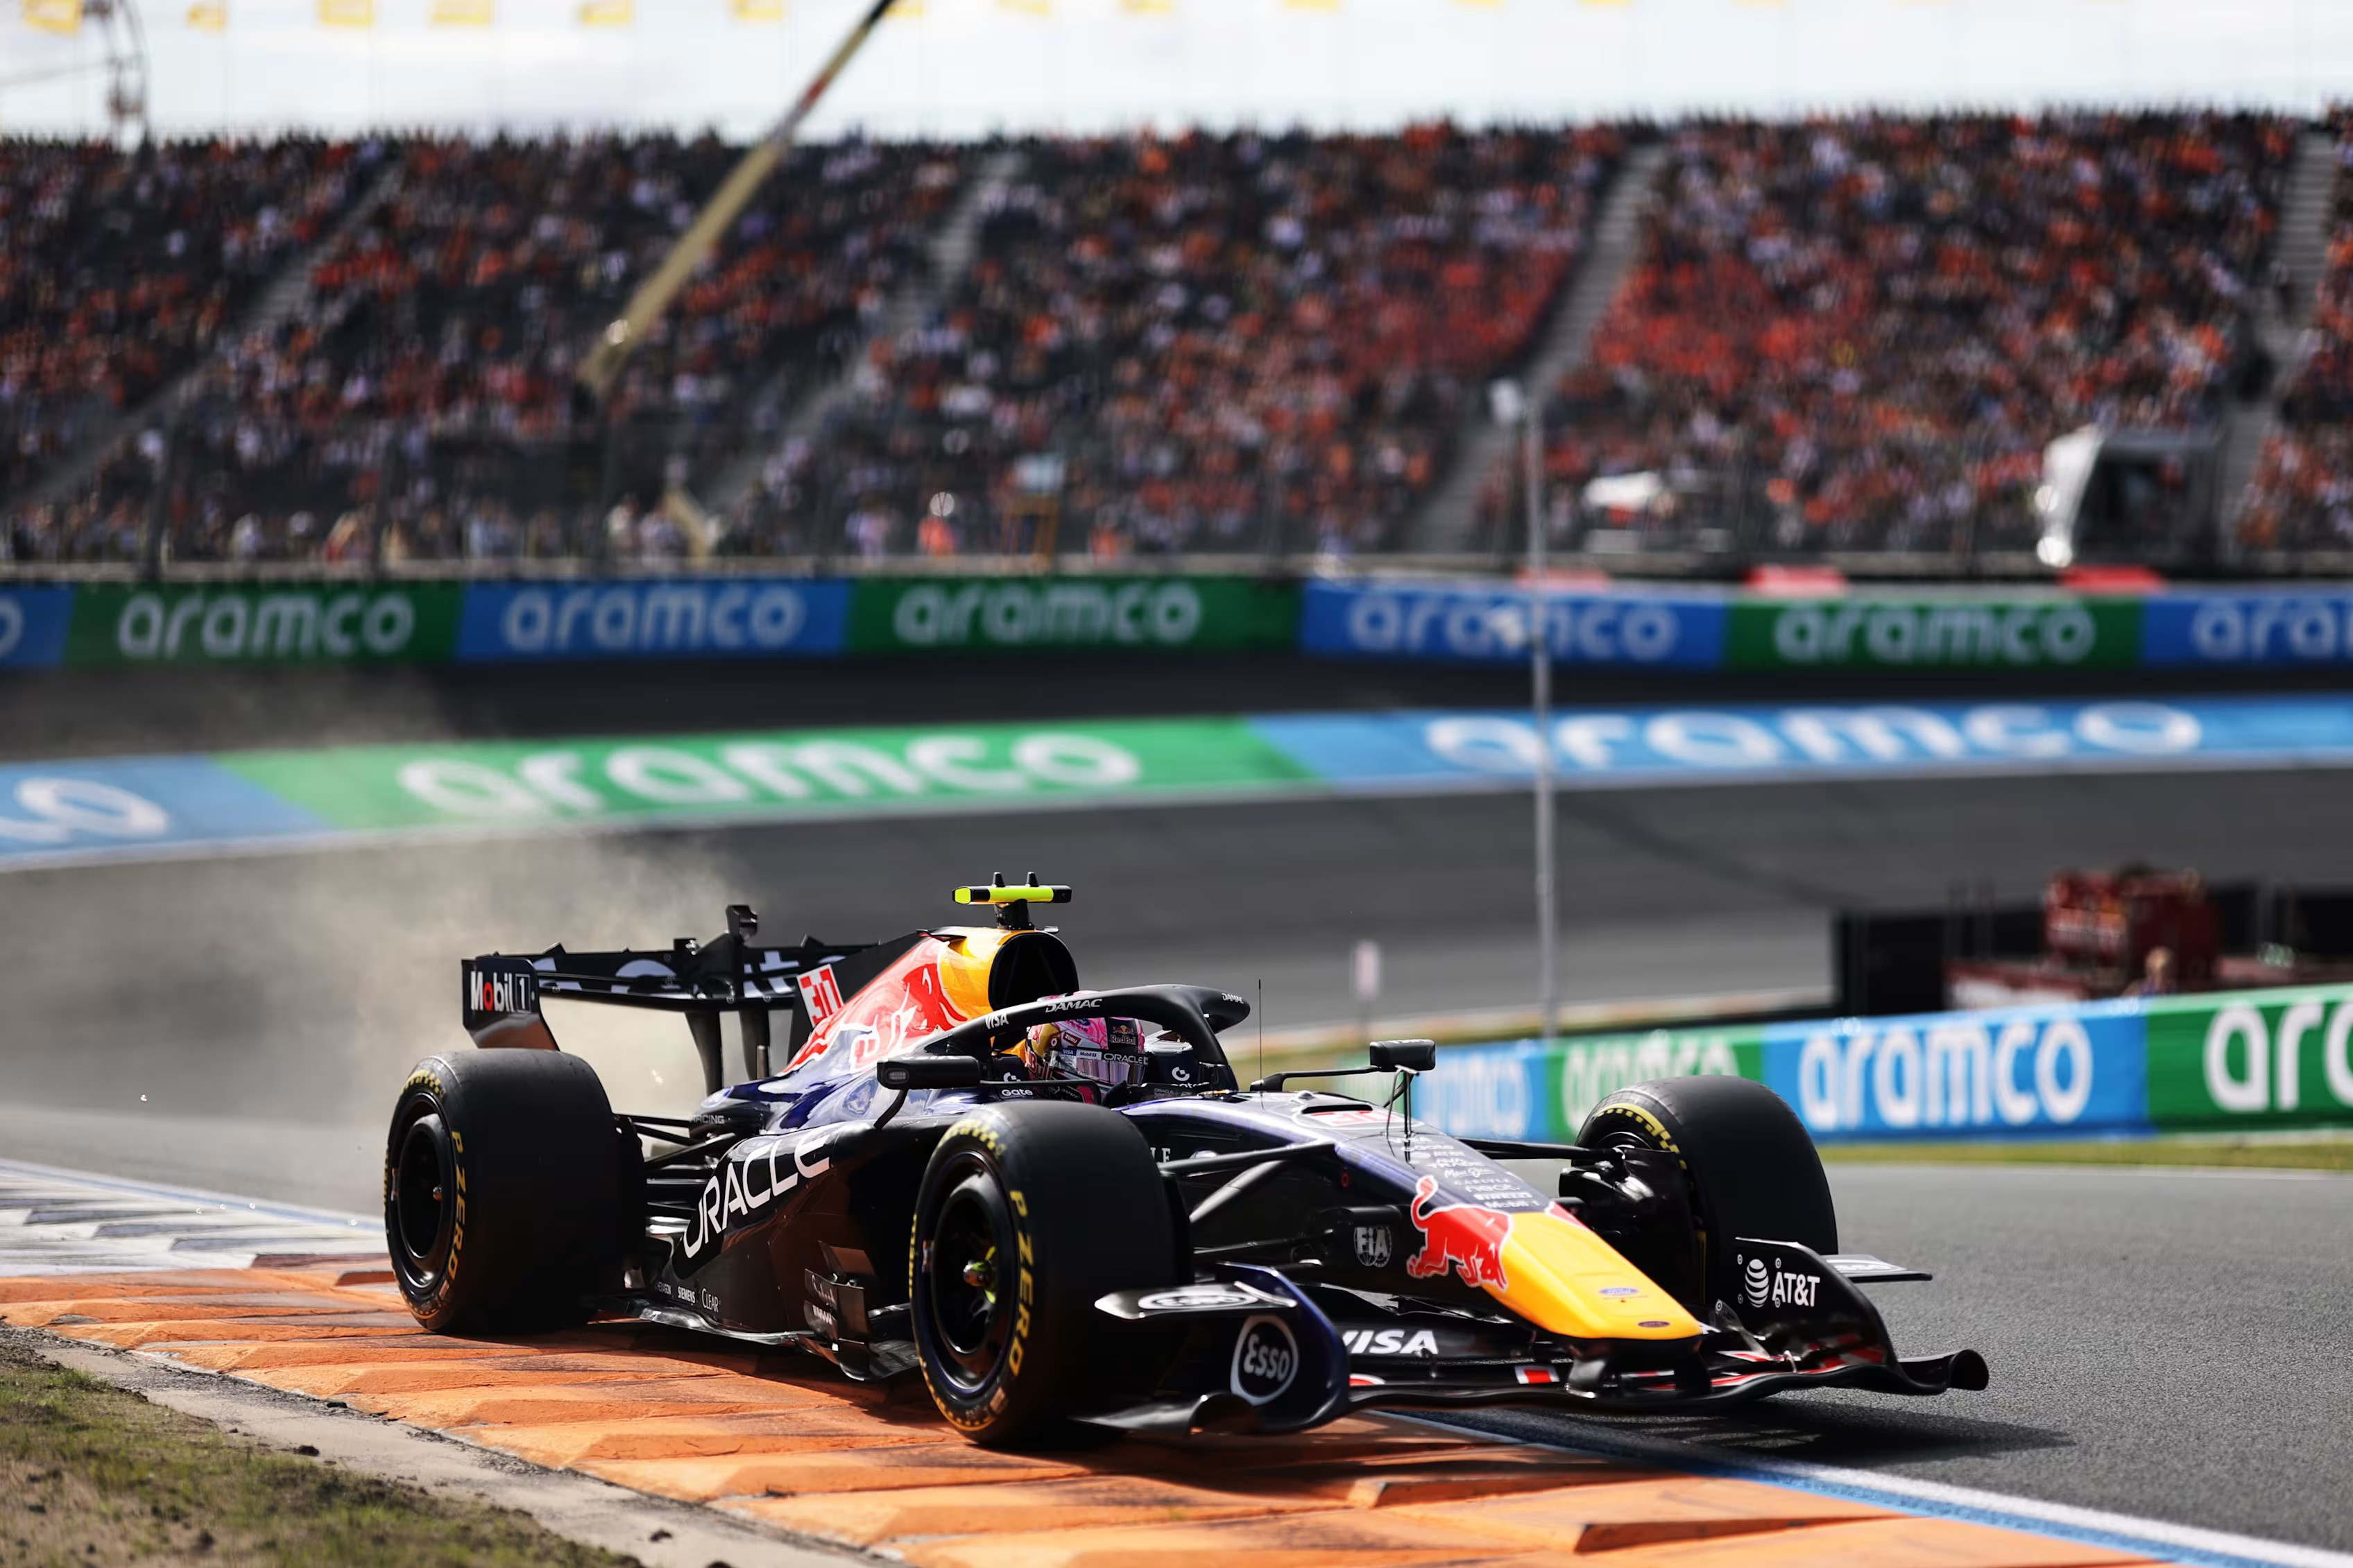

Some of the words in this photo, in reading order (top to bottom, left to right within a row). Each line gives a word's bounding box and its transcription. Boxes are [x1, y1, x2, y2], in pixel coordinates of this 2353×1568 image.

[118, 592, 416, 657] aramco
[503, 585, 807, 649] aramco
[893, 582, 1203, 645] aramco
[1772, 601, 2097, 664] aramco
[2193, 596, 2353, 660] ara
[1426, 702, 2203, 772] aramco
[398, 732, 1142, 817] aramco
[470, 970, 514, 1013] Mobil
[1045, 999, 1103, 1013] DAMAC
[1222, 992, 1244, 1004] DAMAC
[985, 1015, 1009, 1030] VISA
[1104, 1053, 1143, 1065] ORACLE
[1798, 1018, 2094, 1132] aramco
[1001, 1088, 1034, 1096] Gate
[691, 1114, 726, 1125] ACING
[447, 1164, 467, 1280] ZERO
[1010, 1190, 1027, 1218] P
[678, 1286, 696, 1304] SIEMENS
[1009, 1233, 1034, 1377] ZERO
[1772, 1271, 1821, 1307] AT&T
